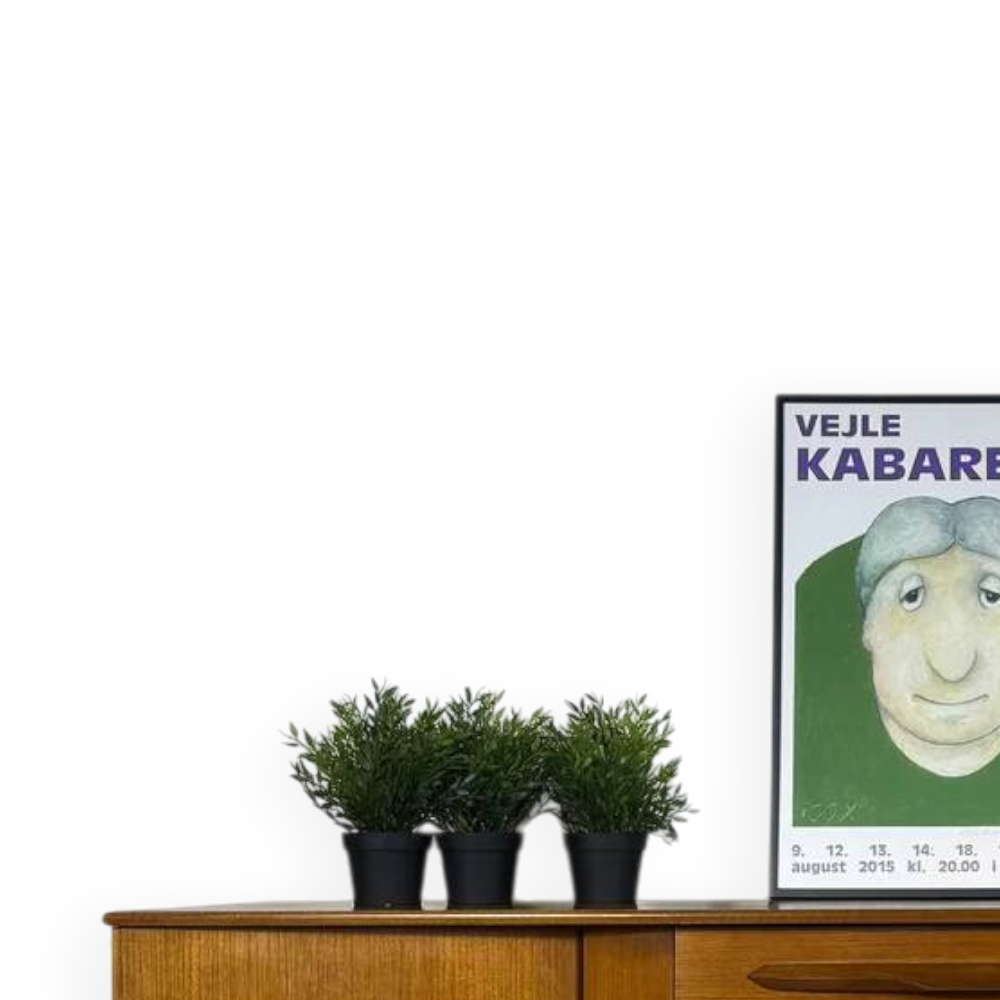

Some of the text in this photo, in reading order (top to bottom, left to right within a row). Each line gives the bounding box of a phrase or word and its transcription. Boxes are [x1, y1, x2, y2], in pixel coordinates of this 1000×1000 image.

[795, 414, 901, 437] VEJLE
[791, 844, 805, 857] 9.
[826, 844, 848, 857] 12.
[869, 844, 891, 857] 13.
[912, 844, 935, 857] 14.
[956, 844, 978, 856] 18.
[791, 861, 847, 875] august
[859, 860, 895, 873] 2015
[907, 860, 926, 873] kl.
[939, 860, 980, 873] 20.00
